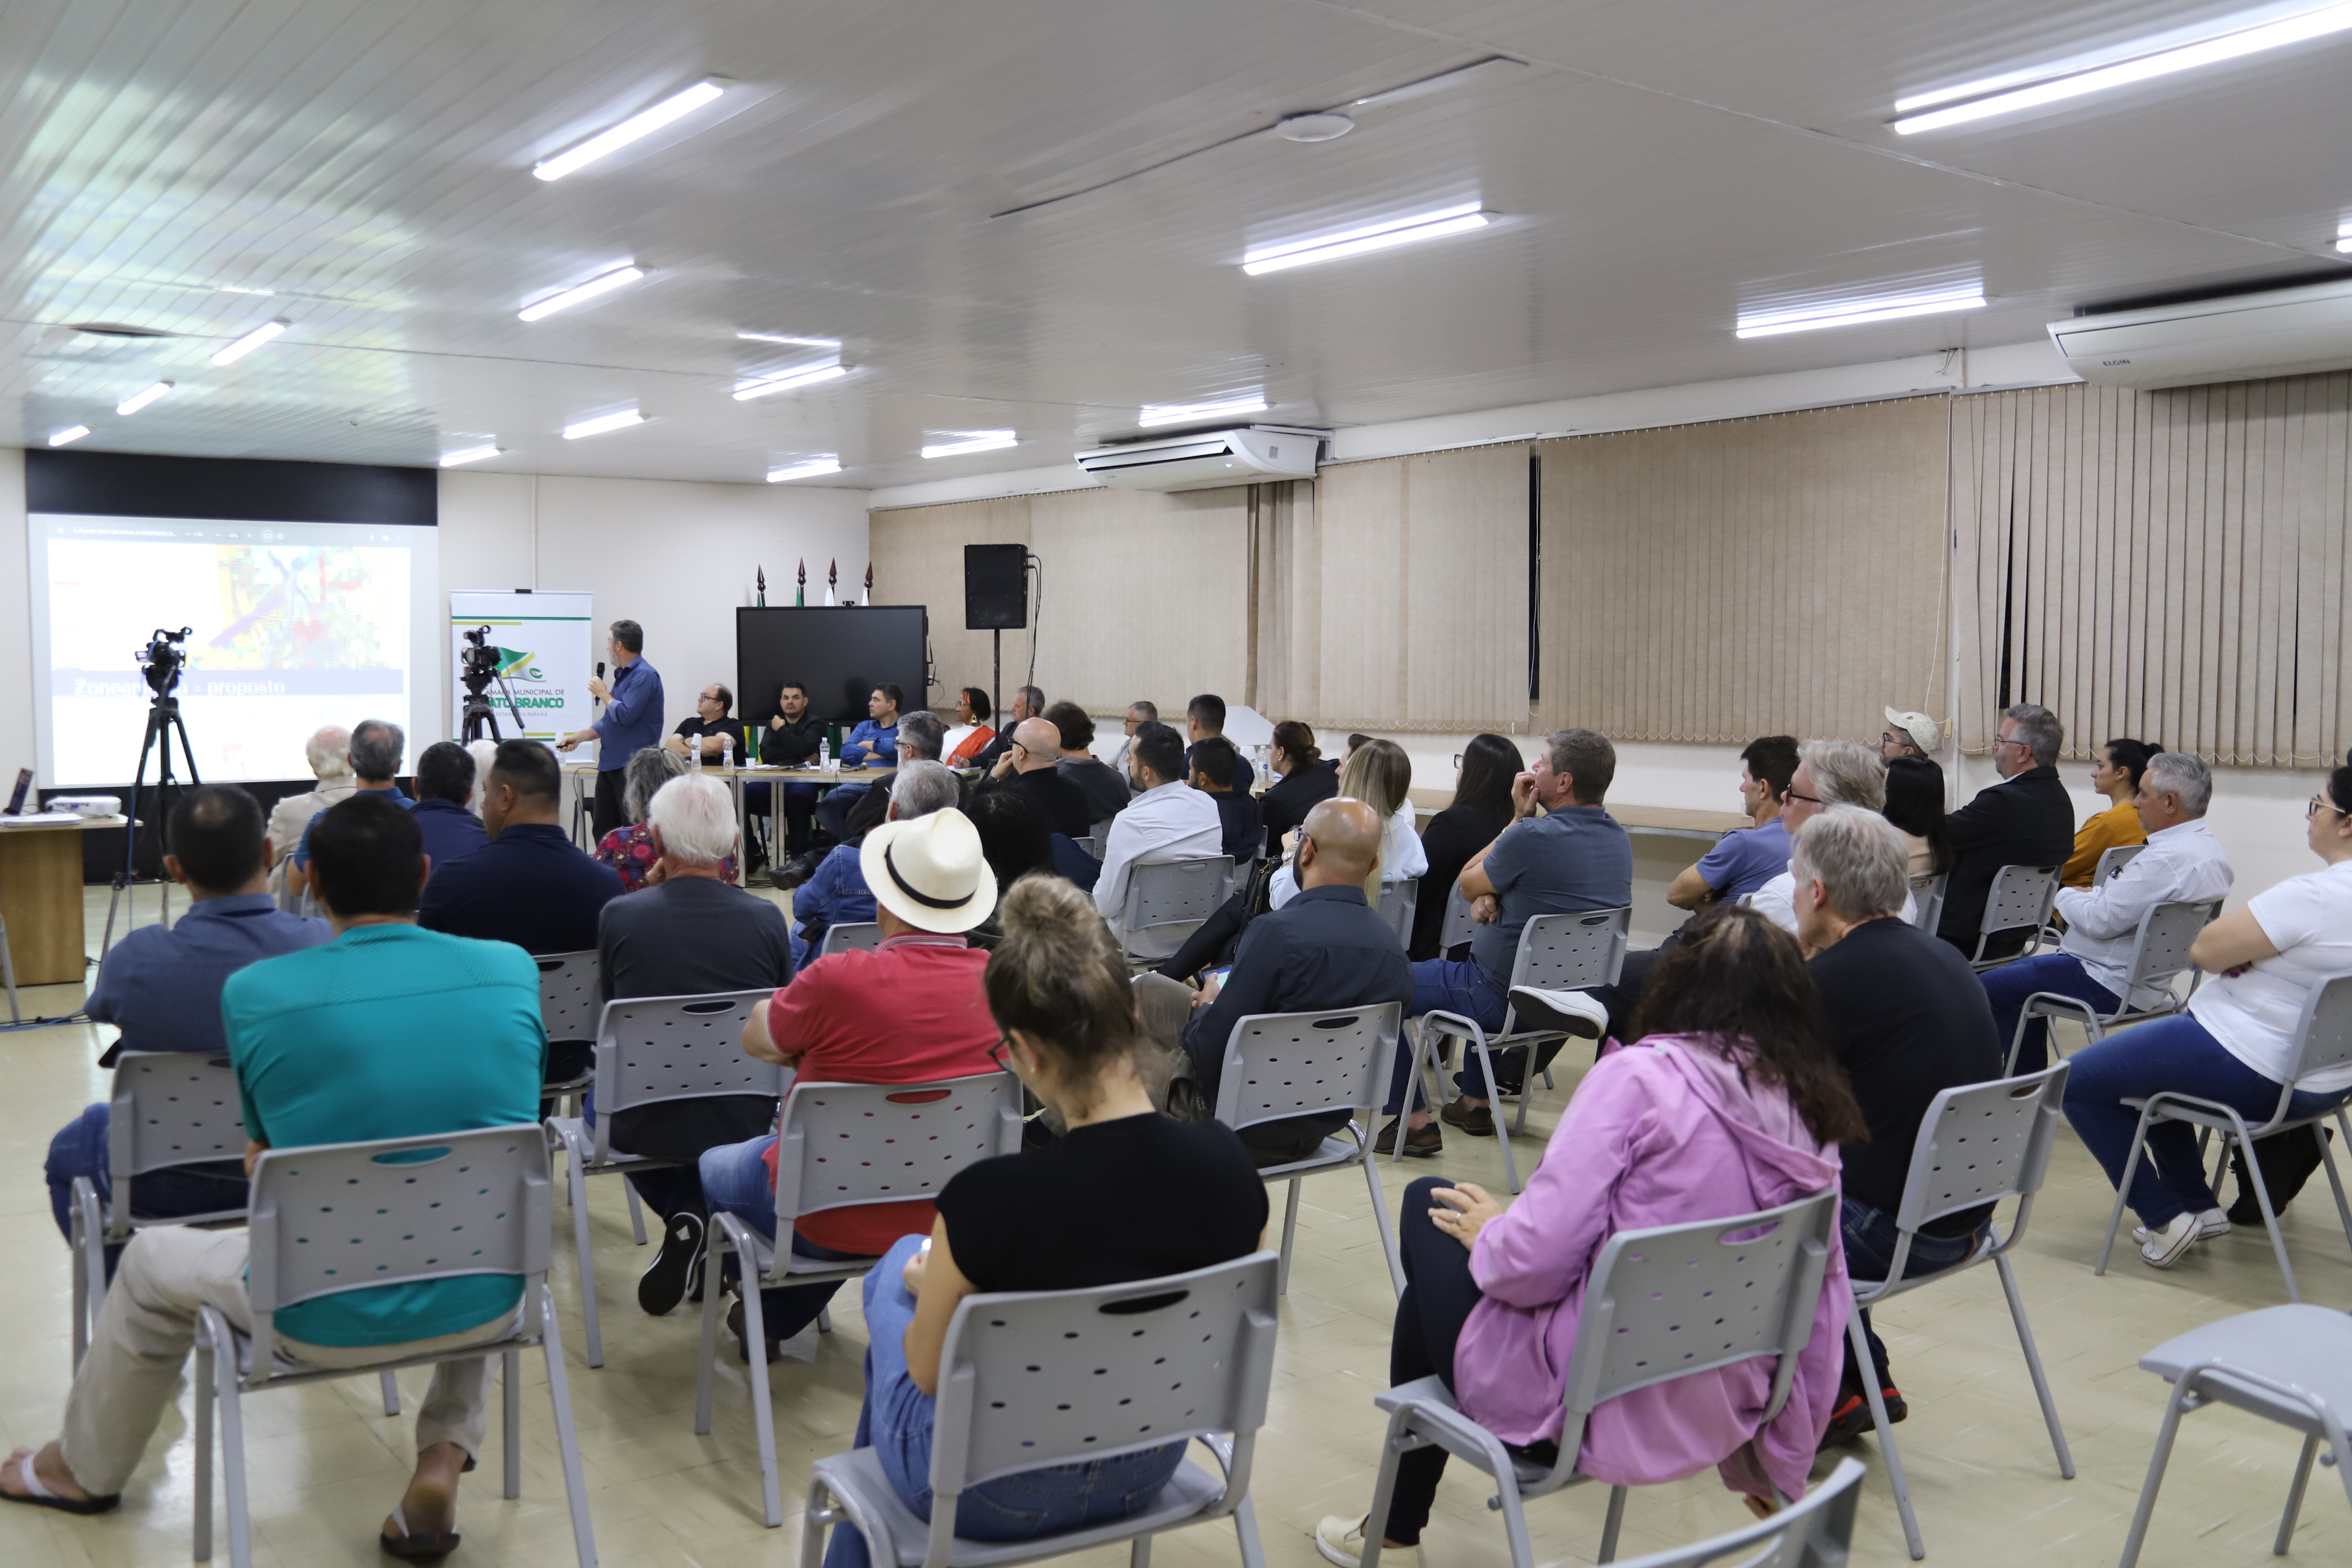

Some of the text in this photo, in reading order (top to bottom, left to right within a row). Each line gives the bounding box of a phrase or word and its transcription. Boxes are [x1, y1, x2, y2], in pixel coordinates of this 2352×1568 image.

[75, 679, 188, 696] Zoneamo
[208, 680, 285, 697] proposto
[488, 697, 565, 708] ATO BRANCO
